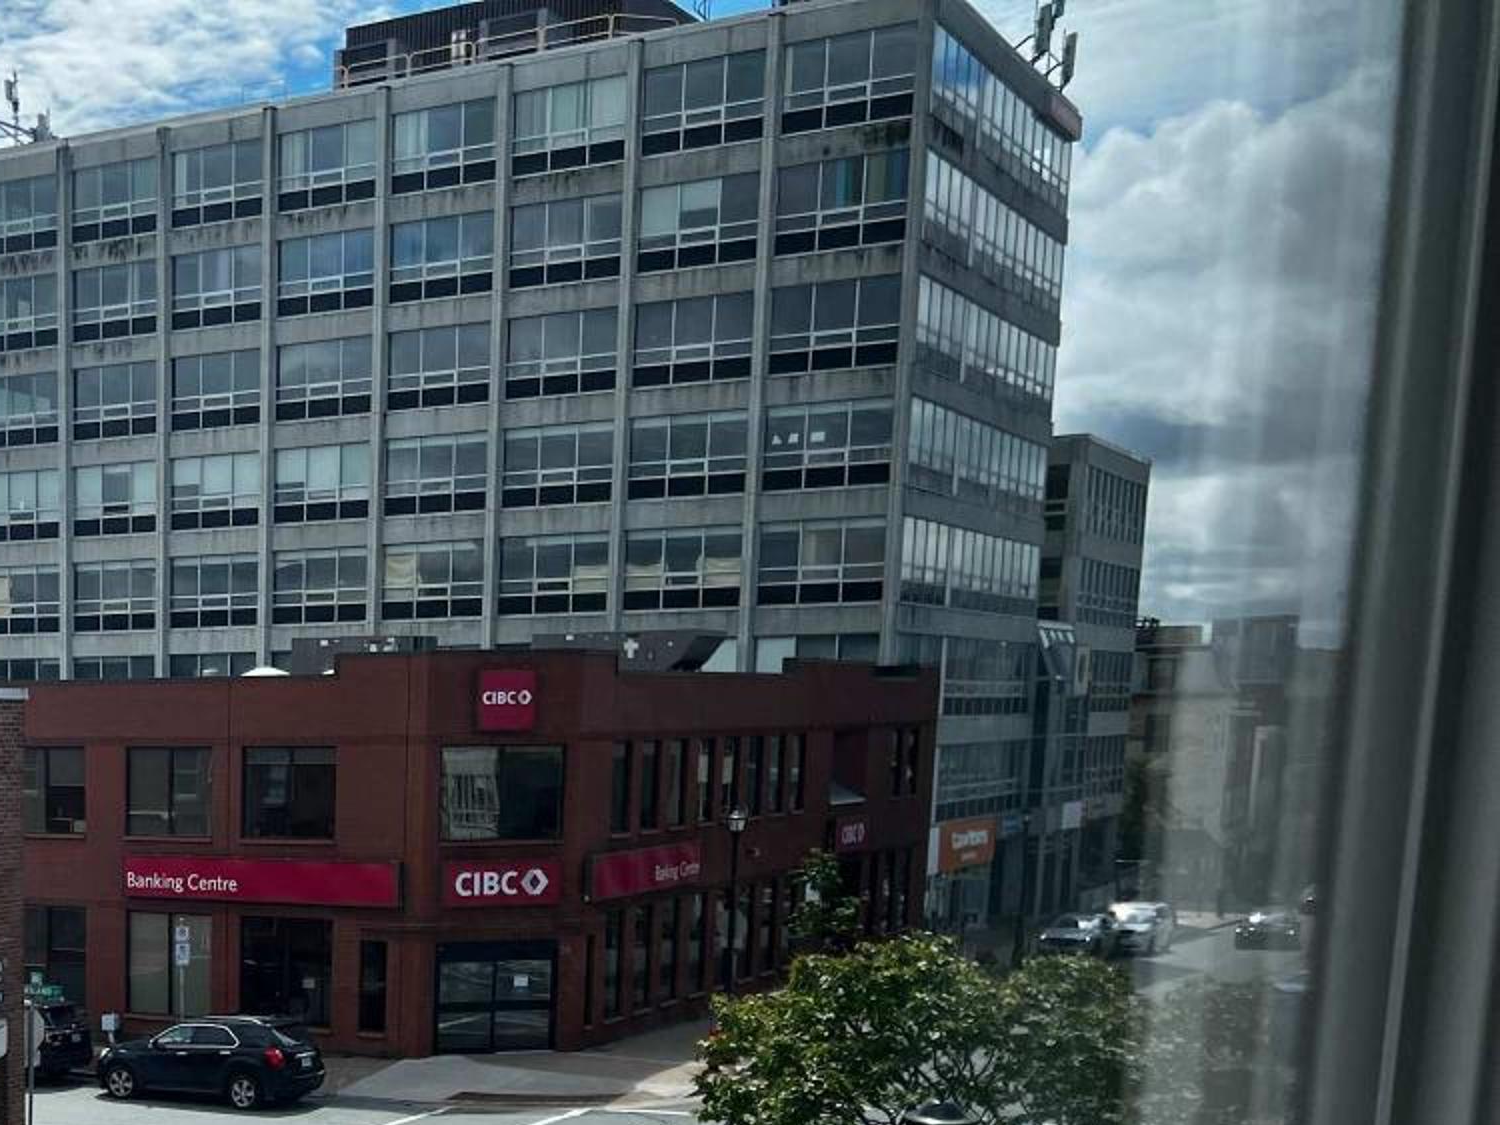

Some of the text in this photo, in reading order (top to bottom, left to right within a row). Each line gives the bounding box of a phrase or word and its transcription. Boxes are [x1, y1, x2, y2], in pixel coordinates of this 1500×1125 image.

[482, 690, 517, 705] CIBC
[126, 871, 238, 893] Banking Centre
[455, 870, 519, 897] CIBC
